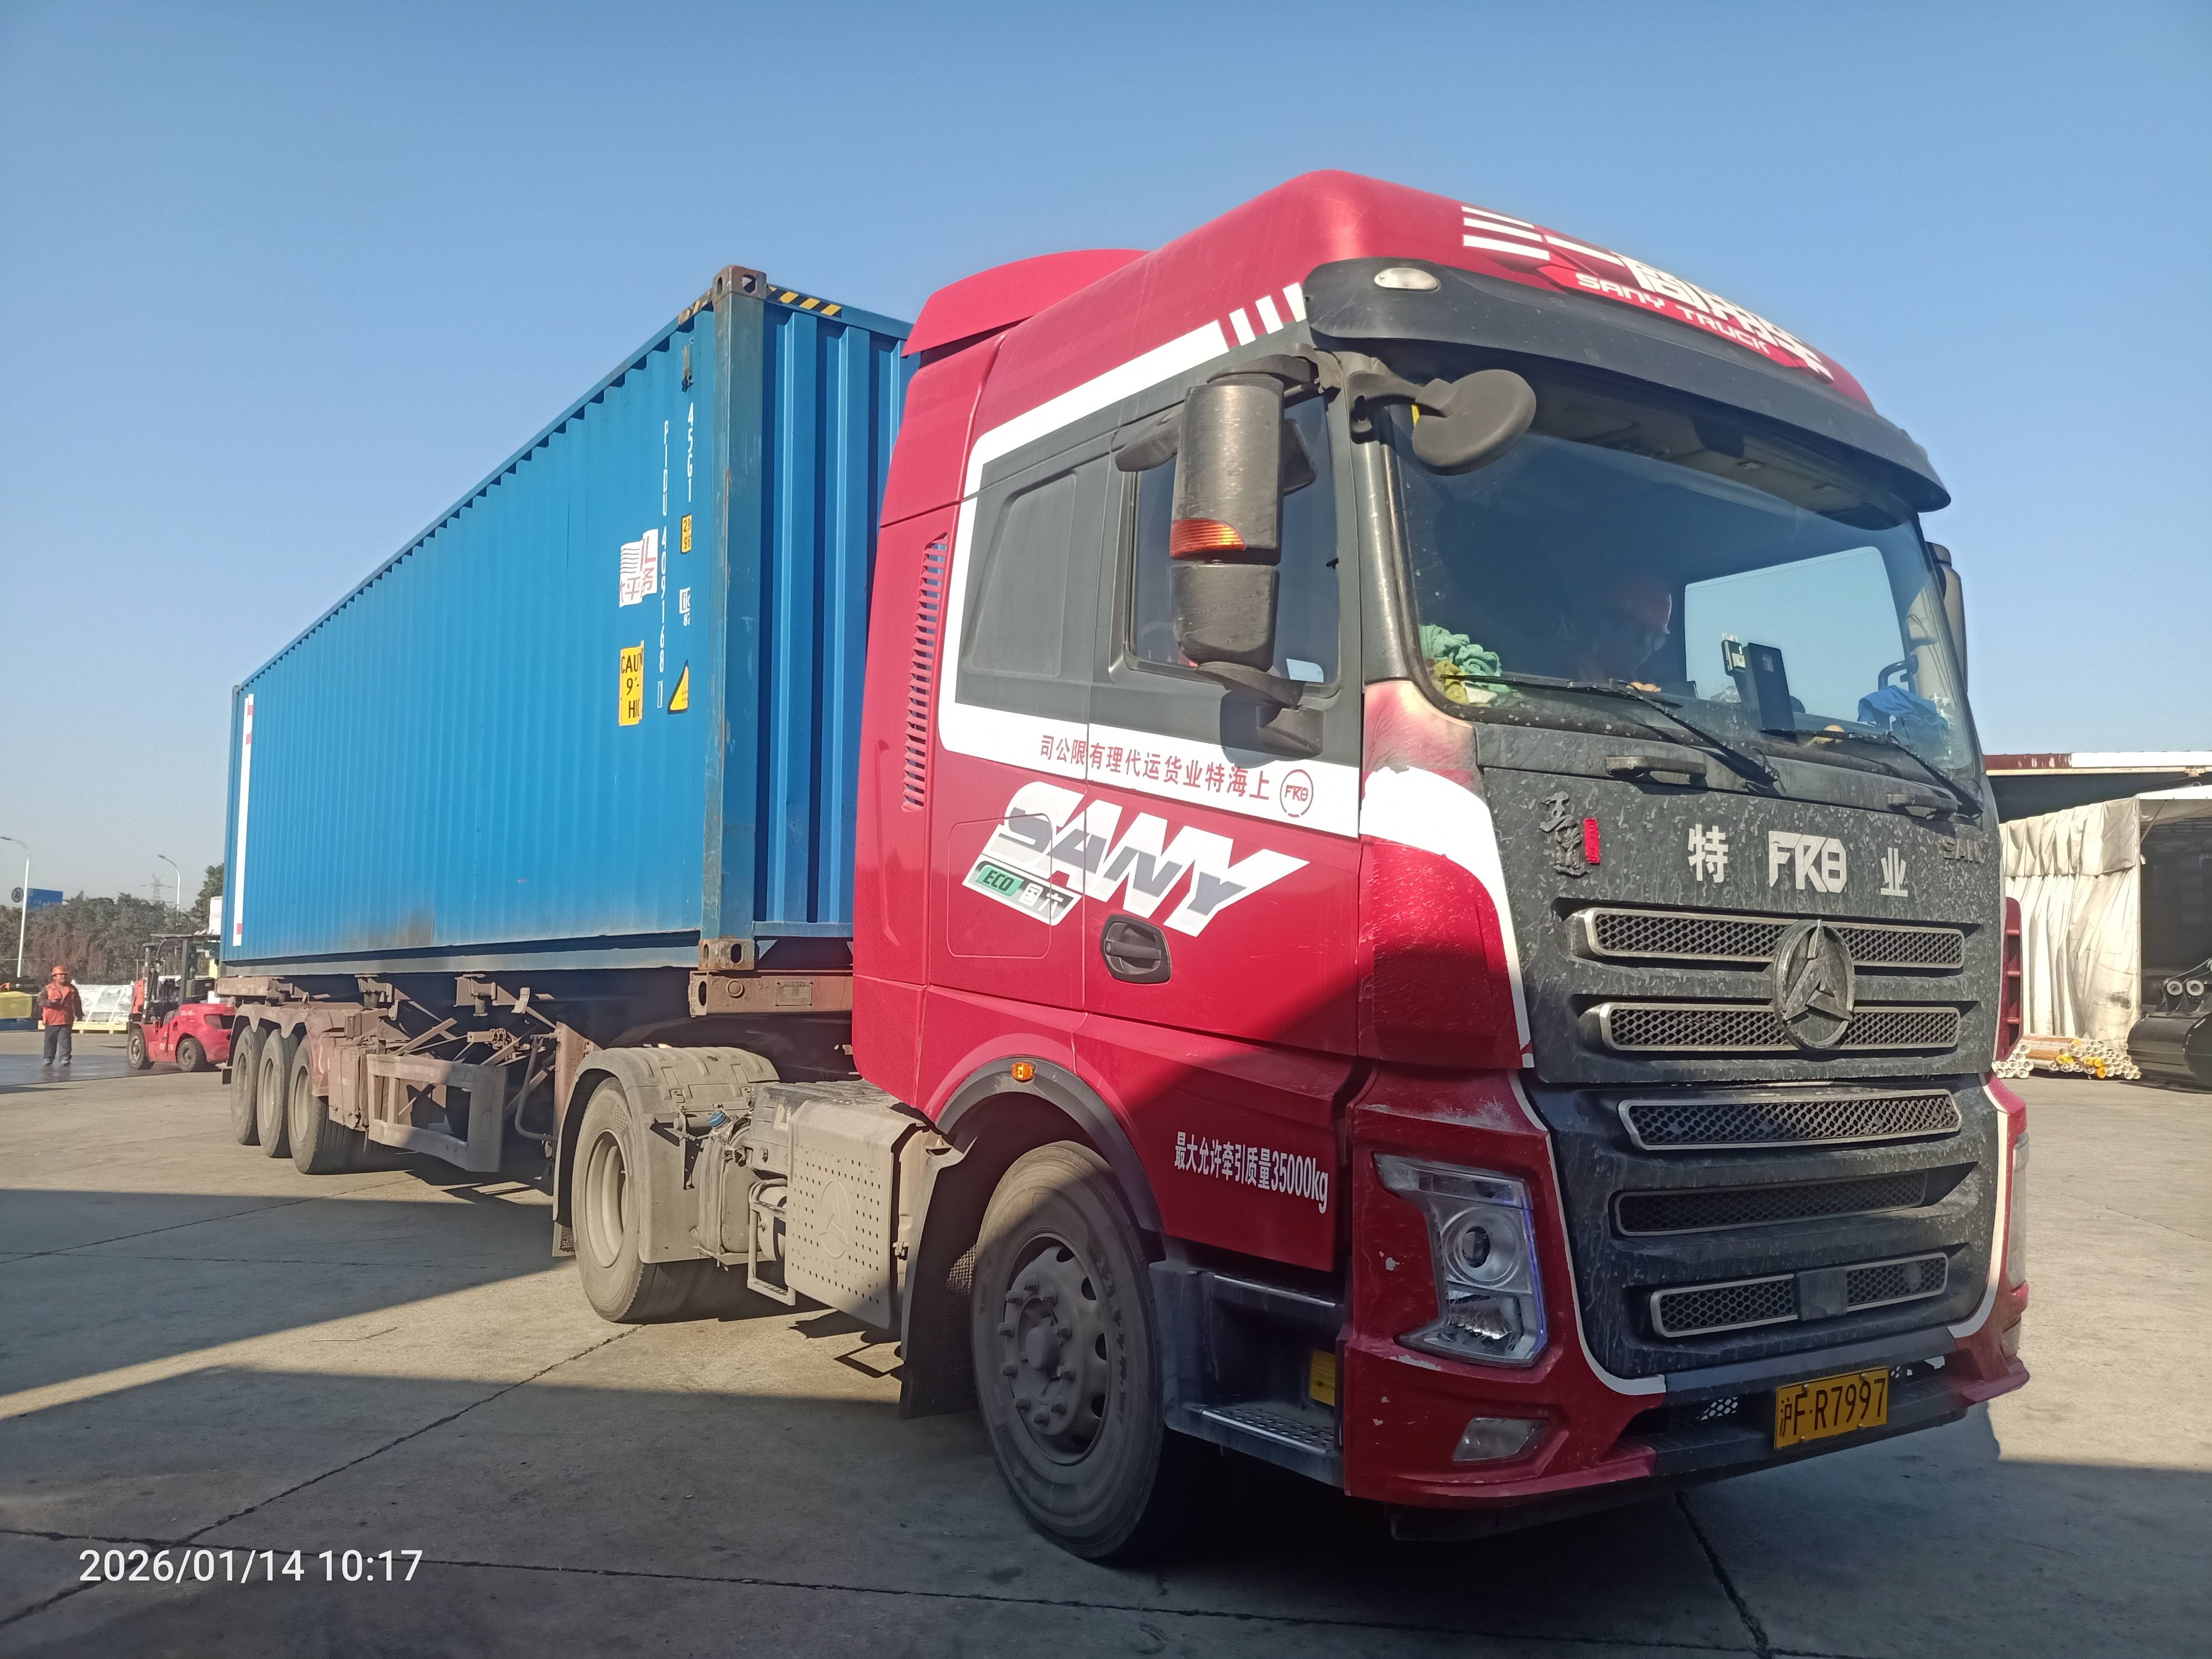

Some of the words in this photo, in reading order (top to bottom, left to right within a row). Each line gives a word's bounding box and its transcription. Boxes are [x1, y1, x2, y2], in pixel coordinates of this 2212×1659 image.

[1576, 273, 1665, 309] SANY
[1676, 305, 1771, 356] TRUCK
[982, 781, 1310, 937] SANY
[982, 869, 1015, 892] ECO
[1018, 882, 1064, 917] 国六
[1688, 823, 1729, 883] 特
[1880, 847, 1908, 898] 业
